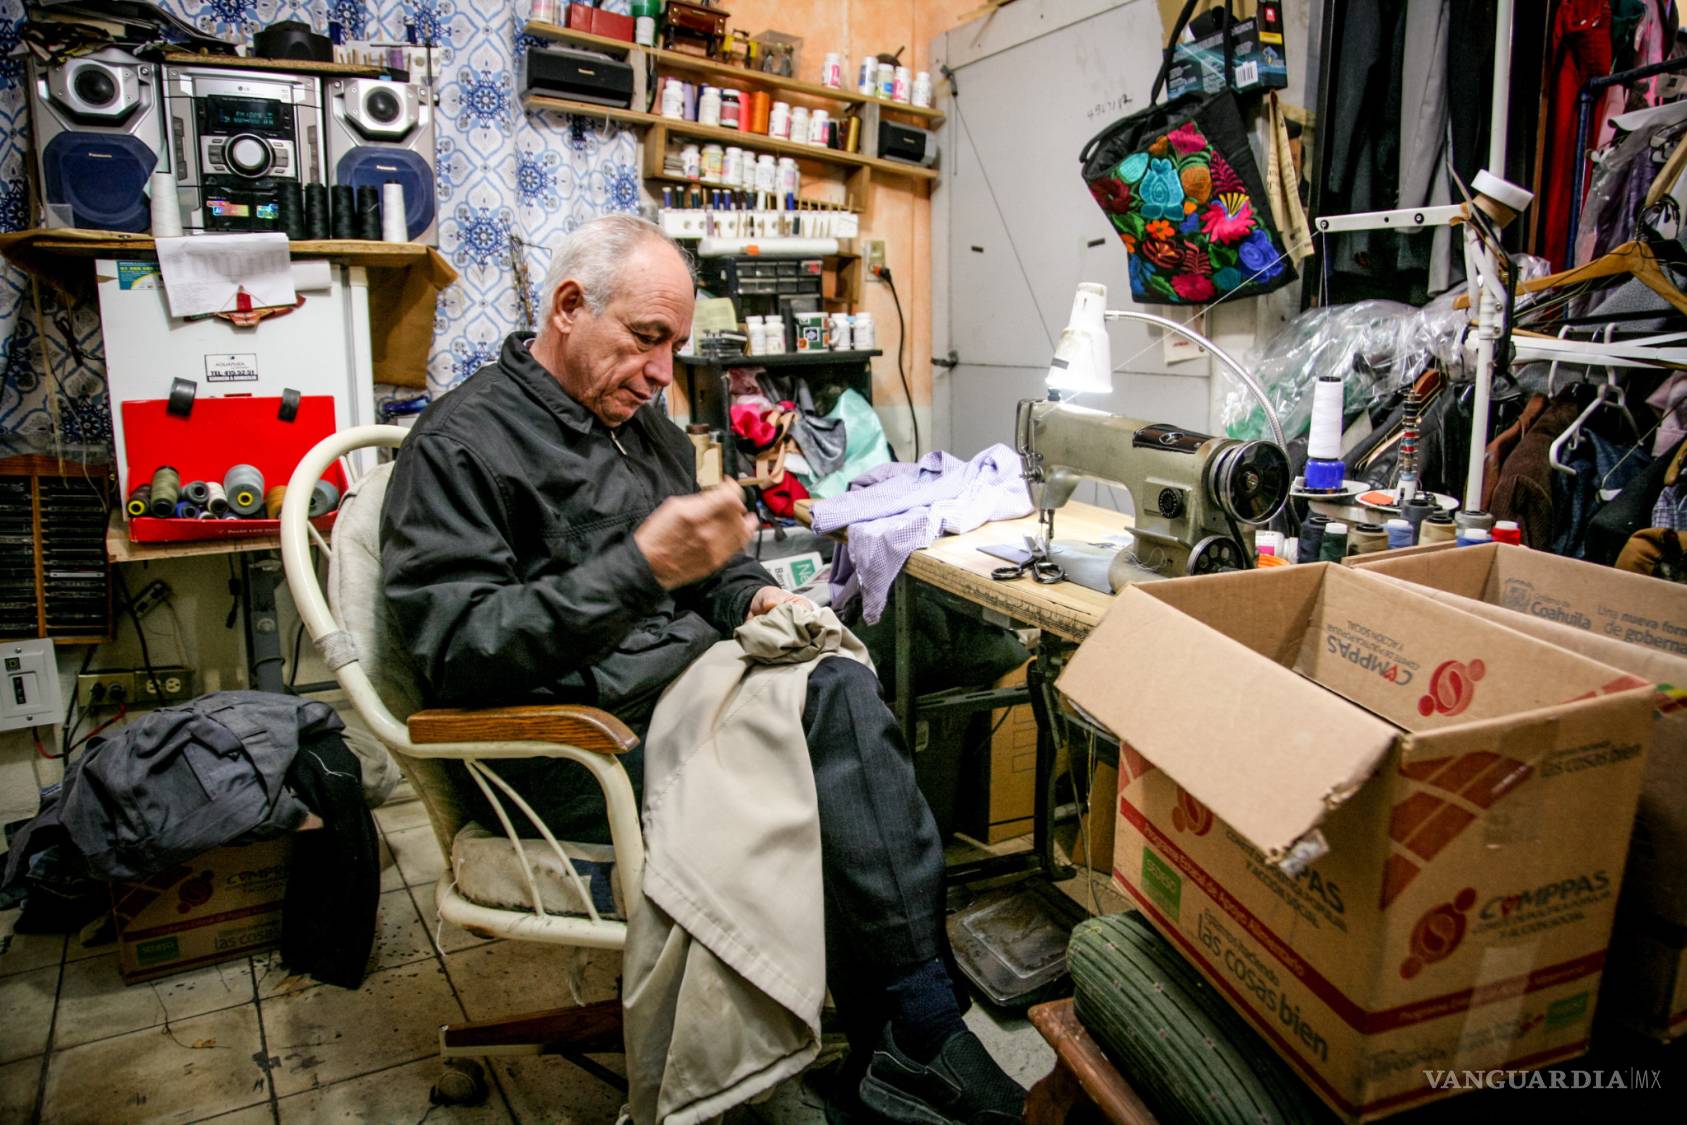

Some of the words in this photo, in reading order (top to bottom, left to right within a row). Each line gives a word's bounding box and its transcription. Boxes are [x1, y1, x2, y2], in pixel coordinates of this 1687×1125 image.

[1531, 601, 1592, 631] Coahuila
[1621, 612, 1659, 630] nueva
[1604, 620, 1622, 637] de
[1198, 912, 1222, 957] las
[1224, 949, 1278, 1013] cosas
[1279, 992, 1329, 1063] bien
